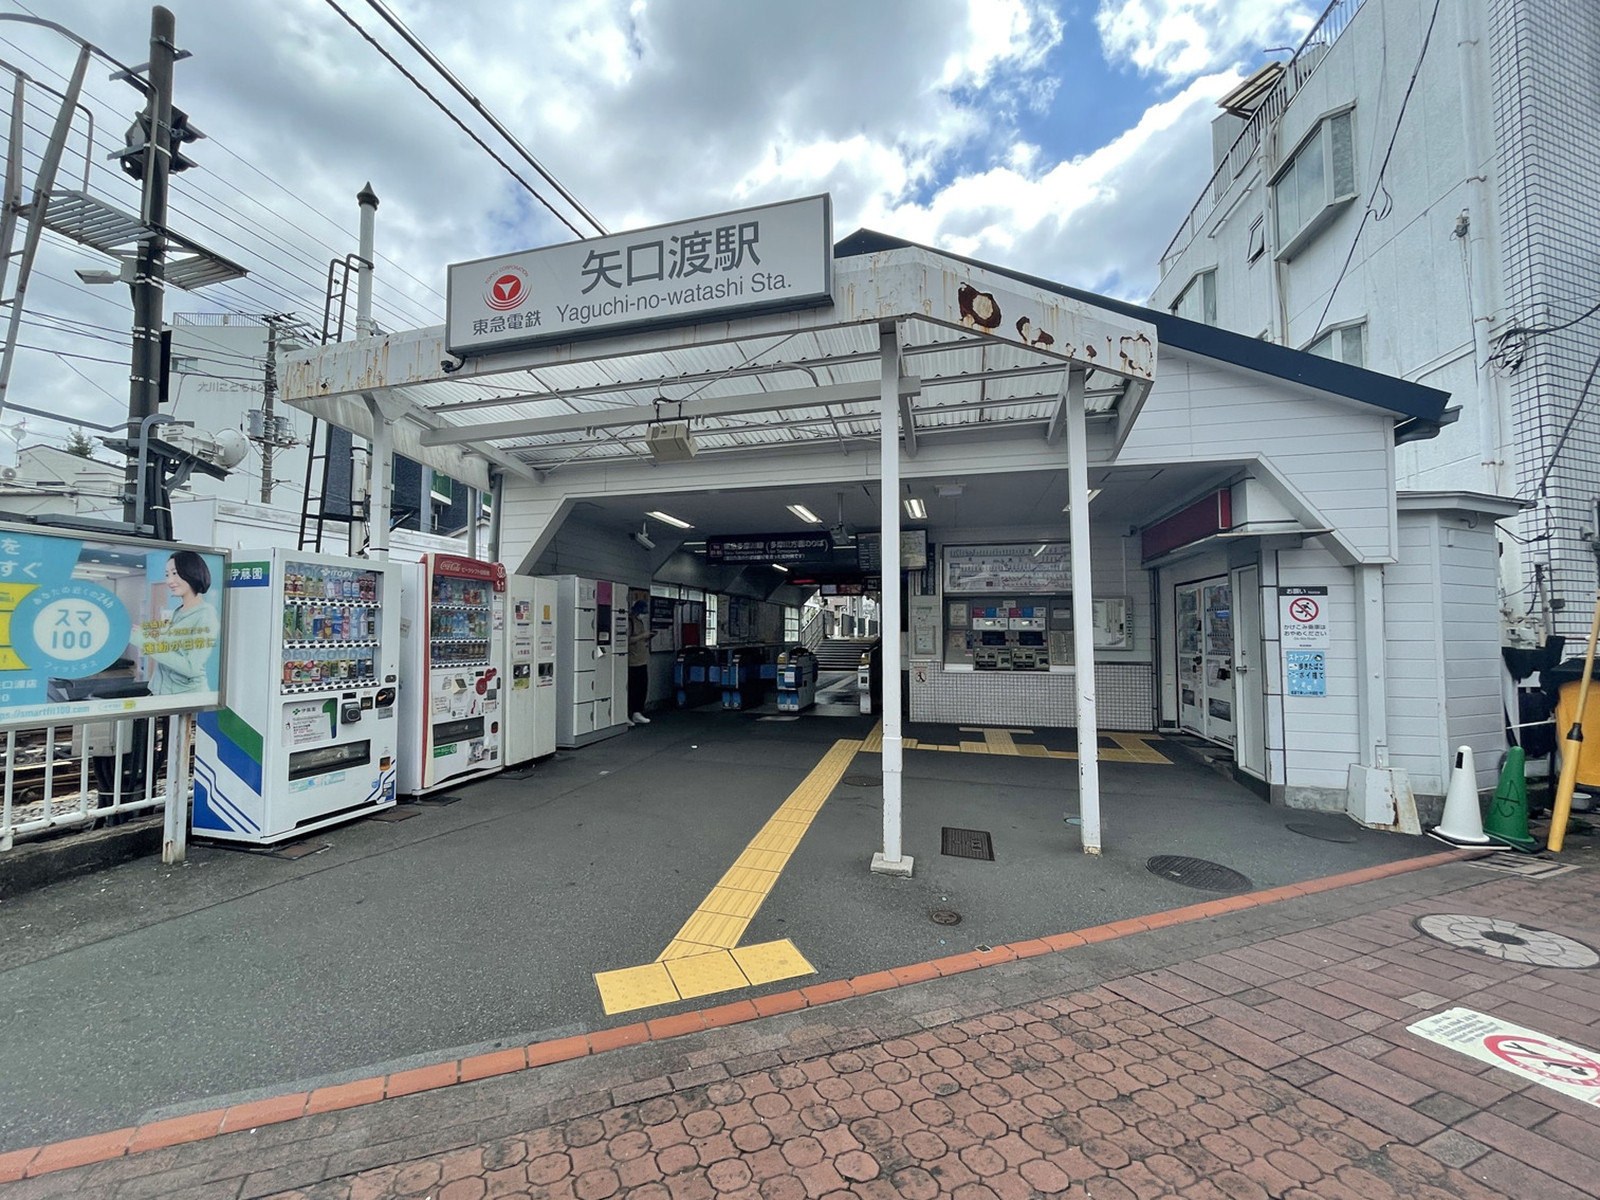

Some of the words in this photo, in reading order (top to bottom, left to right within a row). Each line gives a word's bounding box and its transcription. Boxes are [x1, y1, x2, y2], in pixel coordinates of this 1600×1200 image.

[580, 220, 762, 296] 矢口渡駅
[556, 279, 745, 325] Yaguchi-no-watashi
[750, 272, 793, 295] Sta.
[472, 309, 542, 336] 東急電鉄
[230, 567, 263, 581] 伊藤園
[55, 609, 93, 626] スマ
[52, 630, 92, 649] 100
[44, 660, 98, 673] フィットネス
